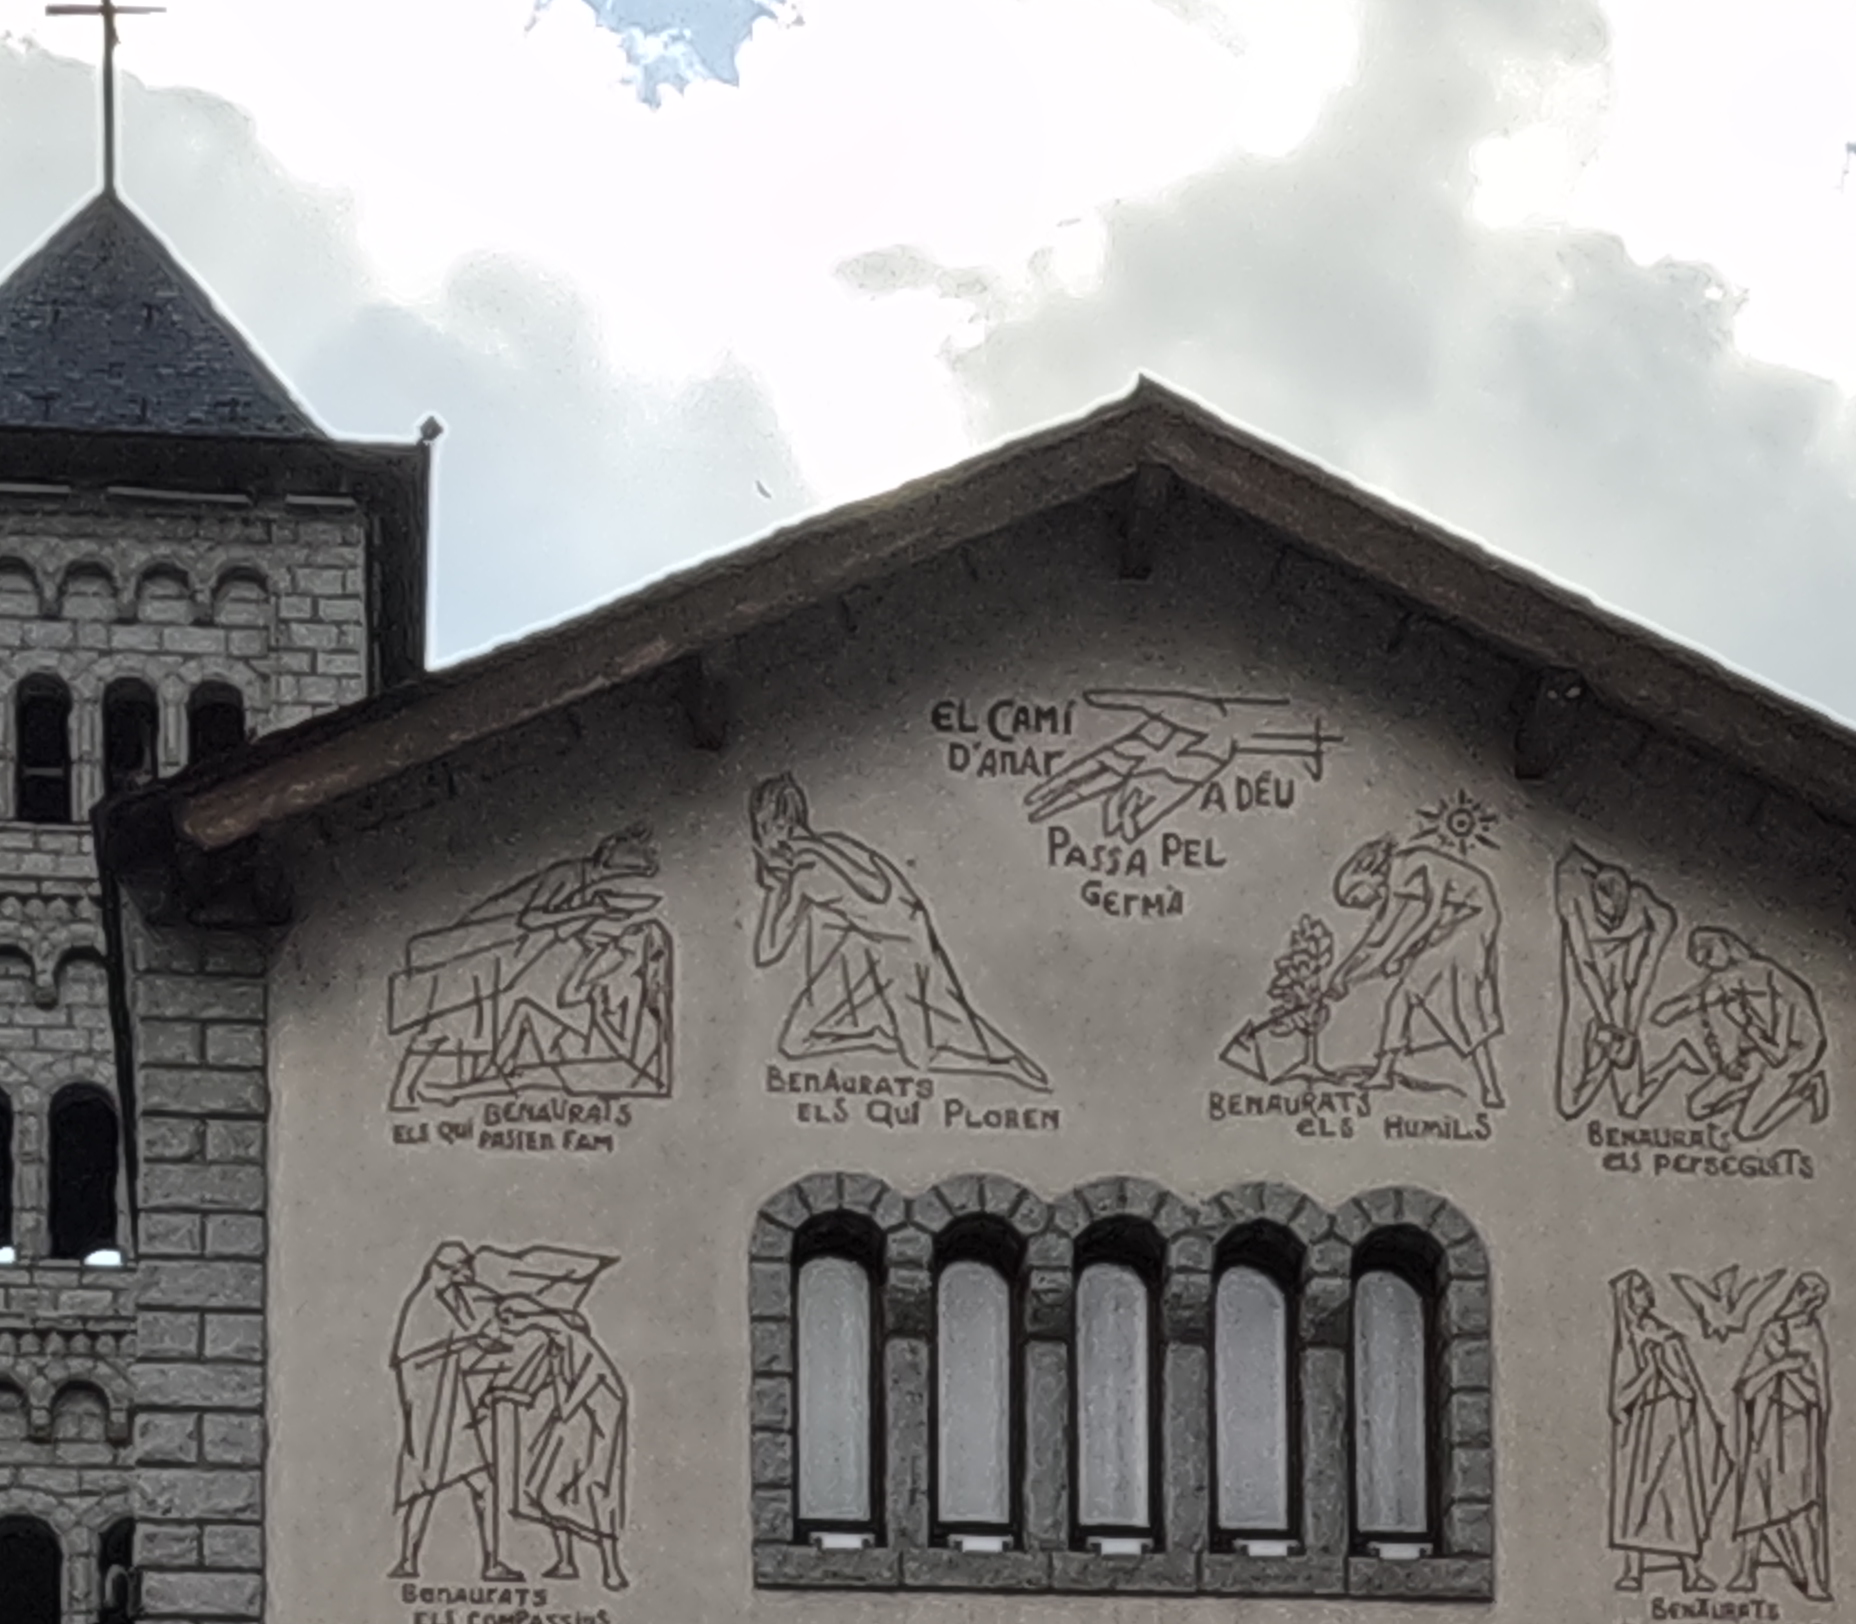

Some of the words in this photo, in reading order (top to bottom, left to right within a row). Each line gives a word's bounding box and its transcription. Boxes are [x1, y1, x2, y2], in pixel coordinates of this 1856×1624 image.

[931, 700, 978, 734] EL
[987, 700, 1075, 741] CAMÍ
[1199, 779, 1226, 811] A
[1235, 772, 1295, 809] DÉU
[1048, 826, 1147, 875] PASSA
[1161, 832, 1227, 868] PEL
[483, 1097, 632, 1126] BENAURATS
[797, 1097, 848, 1123] ELS
[944, 1099, 1060, 1129] PLOREN
[1209, 1091, 1371, 1120] BENAURATS
[393, 1123, 429, 1144] ELS
[562, 1129, 613, 1152] FAM
